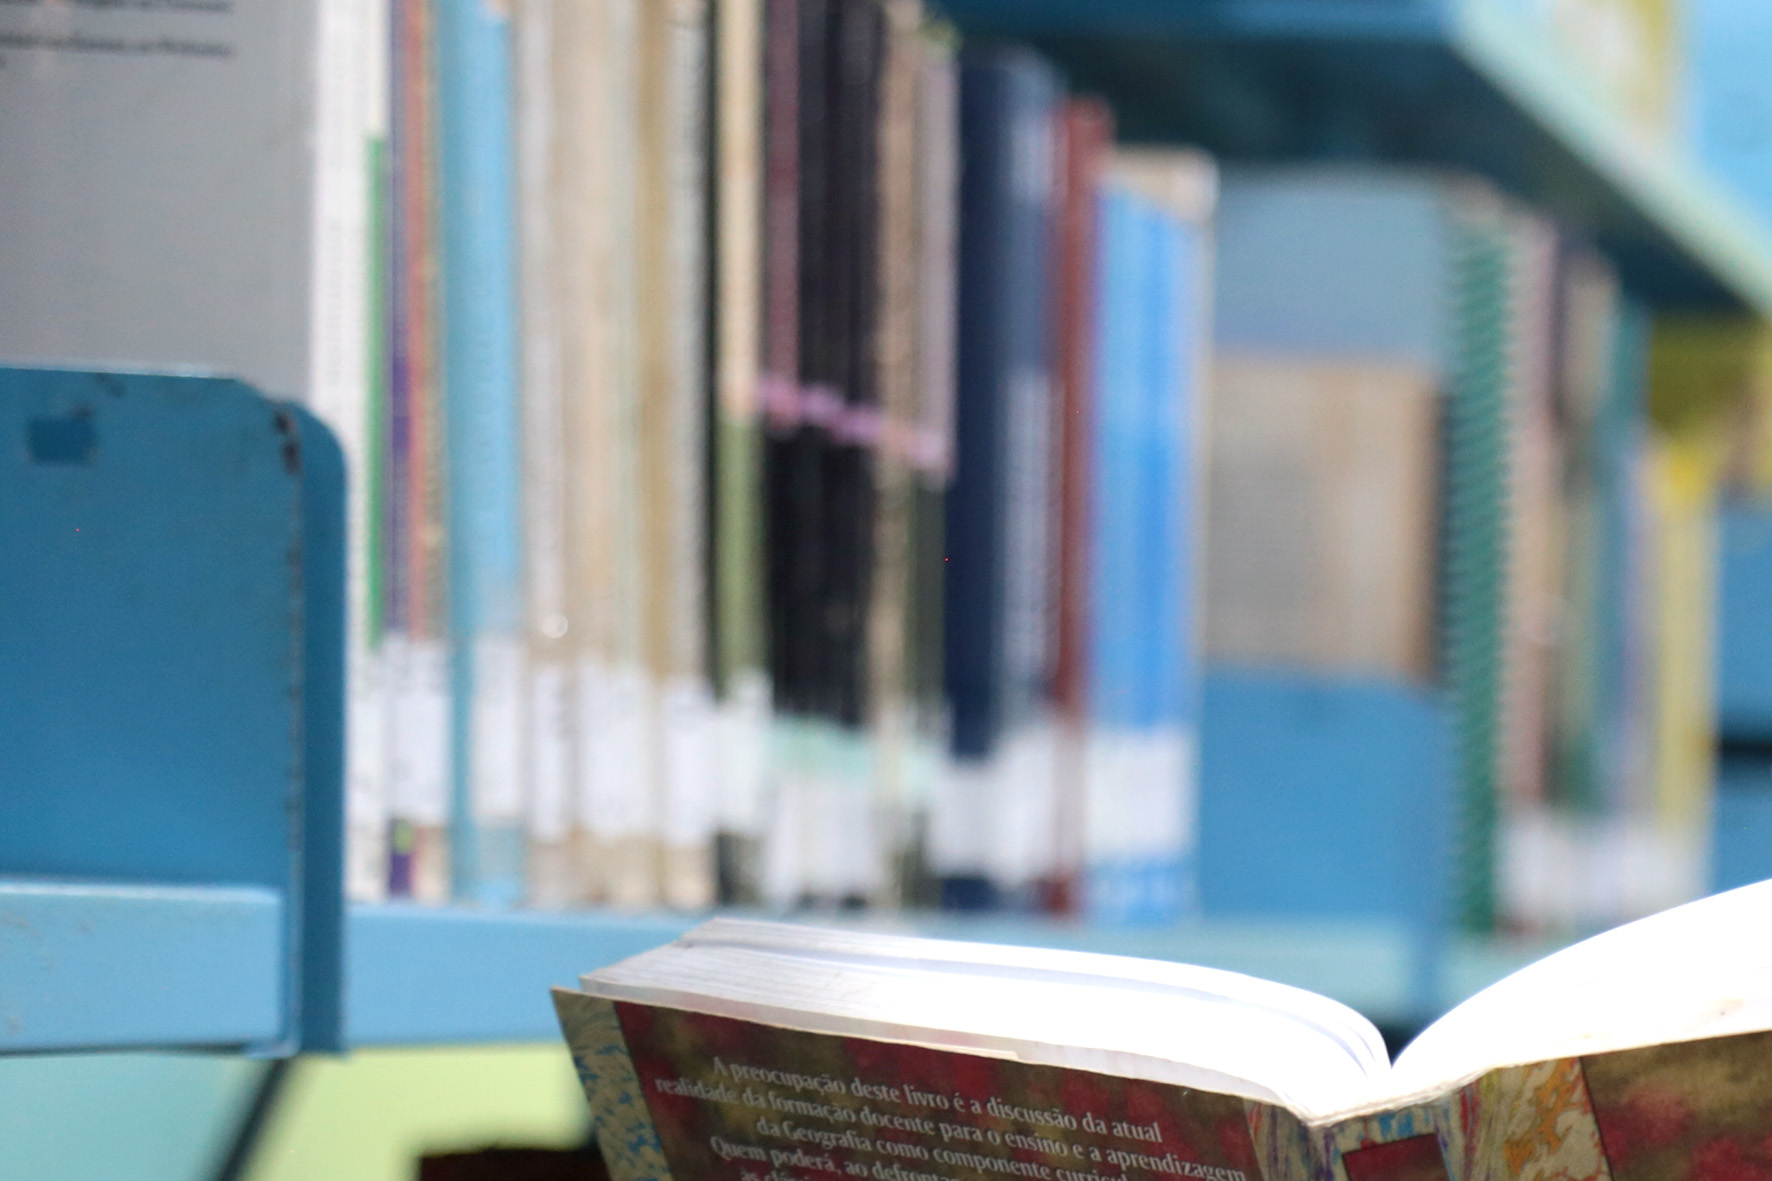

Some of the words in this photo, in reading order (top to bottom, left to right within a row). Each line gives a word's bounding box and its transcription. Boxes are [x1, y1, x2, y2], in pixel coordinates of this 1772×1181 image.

[728, 1062, 848, 1095] preocupação
[846, 1075, 903, 1102] deste
[901, 1083, 950, 1110] livro
[983, 1096, 1079, 1130] discussão
[1078, 1111, 1109, 1135] da
[1109, 1120, 1164, 1144] atual
[739, 1086, 768, 1109] da
[766, 1091, 858, 1125] formação
[856, 1105, 937, 1136] docente
[937, 1122, 985, 1143] para
[1003, 1132, 1070, 1157] ensino
[707, 1133, 768, 1161] Quem
[841, 1159, 869, 1177] ao
[752, 1114, 781, 1137] da
[780, 1118, 874, 1152] Geografia
[873, 1138, 930, 1161] como
[930, 1147, 1053, 1181] componente
